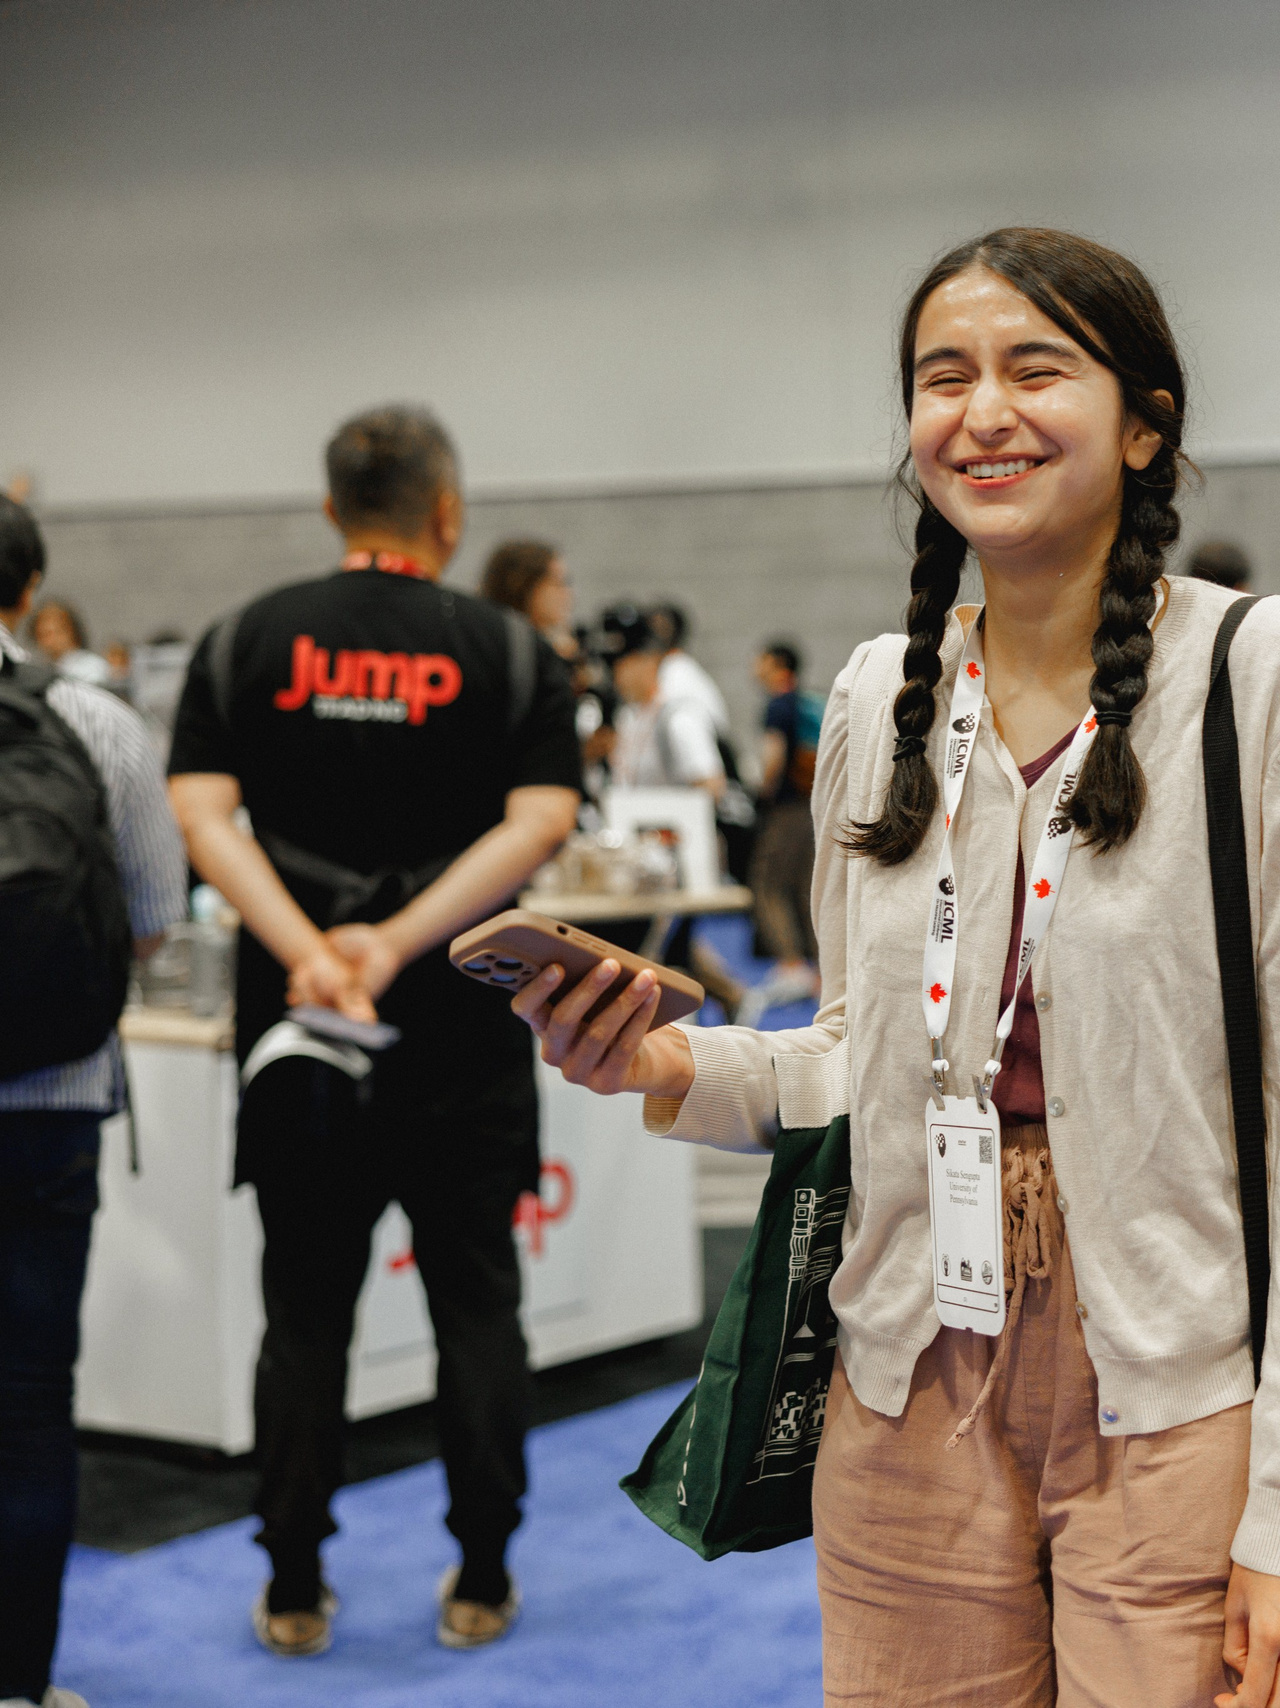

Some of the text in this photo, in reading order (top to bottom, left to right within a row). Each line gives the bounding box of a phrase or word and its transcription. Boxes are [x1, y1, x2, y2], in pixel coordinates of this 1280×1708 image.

[273, 635, 464, 726] Jump
[954, 738, 971, 778] ICML
[940, 900, 955, 943] ICML
[949, 1181, 978, 1194] University of
[949, 1194, 978, 1206] Pennsylvania
